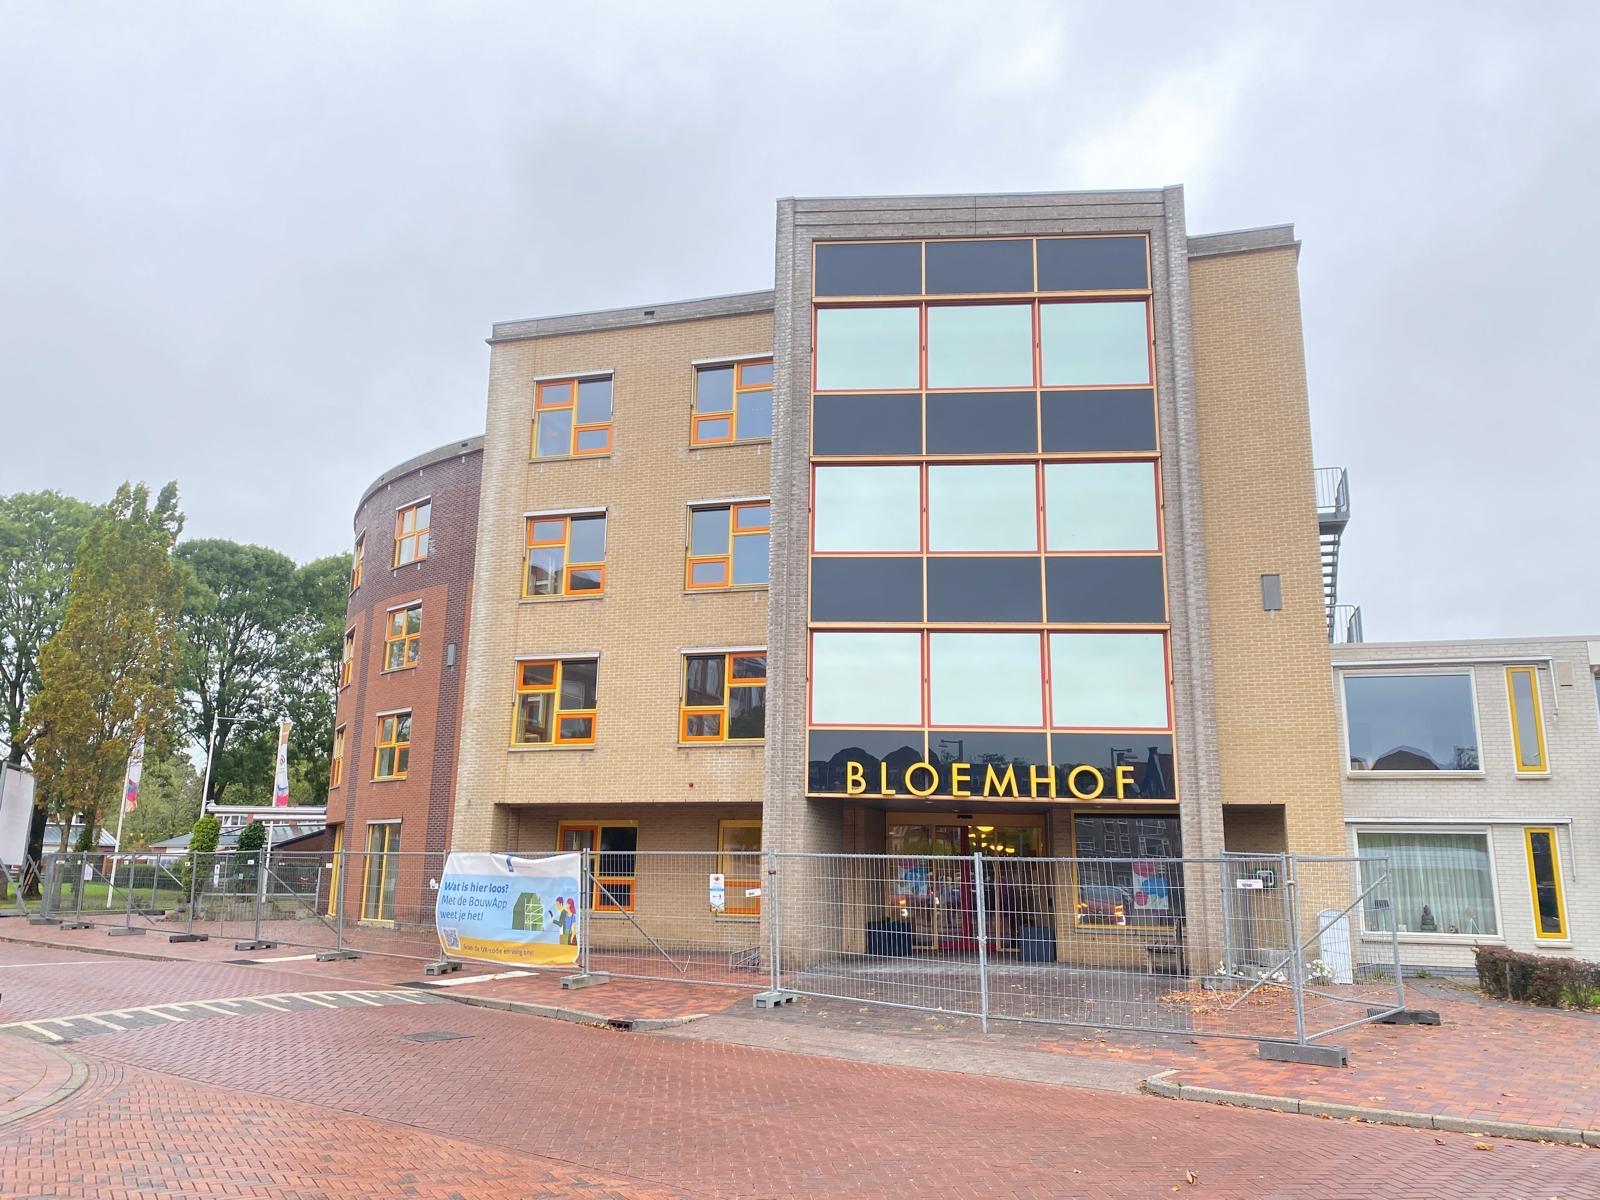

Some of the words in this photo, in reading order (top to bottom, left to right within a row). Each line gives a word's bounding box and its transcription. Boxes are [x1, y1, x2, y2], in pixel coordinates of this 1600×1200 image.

[846, 761, 1135, 800] BLOEMHOF
[445, 881, 460, 891] Wat
[461, 882, 469, 891] is
[470, 882, 488, 892] hier
[489, 883, 509, 894] loos?
[442, 895, 456, 905] Met
[457, 896, 467, 906] de
[469, 896, 508, 909] BouwApp
[440, 911, 457, 919] weet
[458, 909, 466, 922] je
[467, 910, 484, 921] het!
